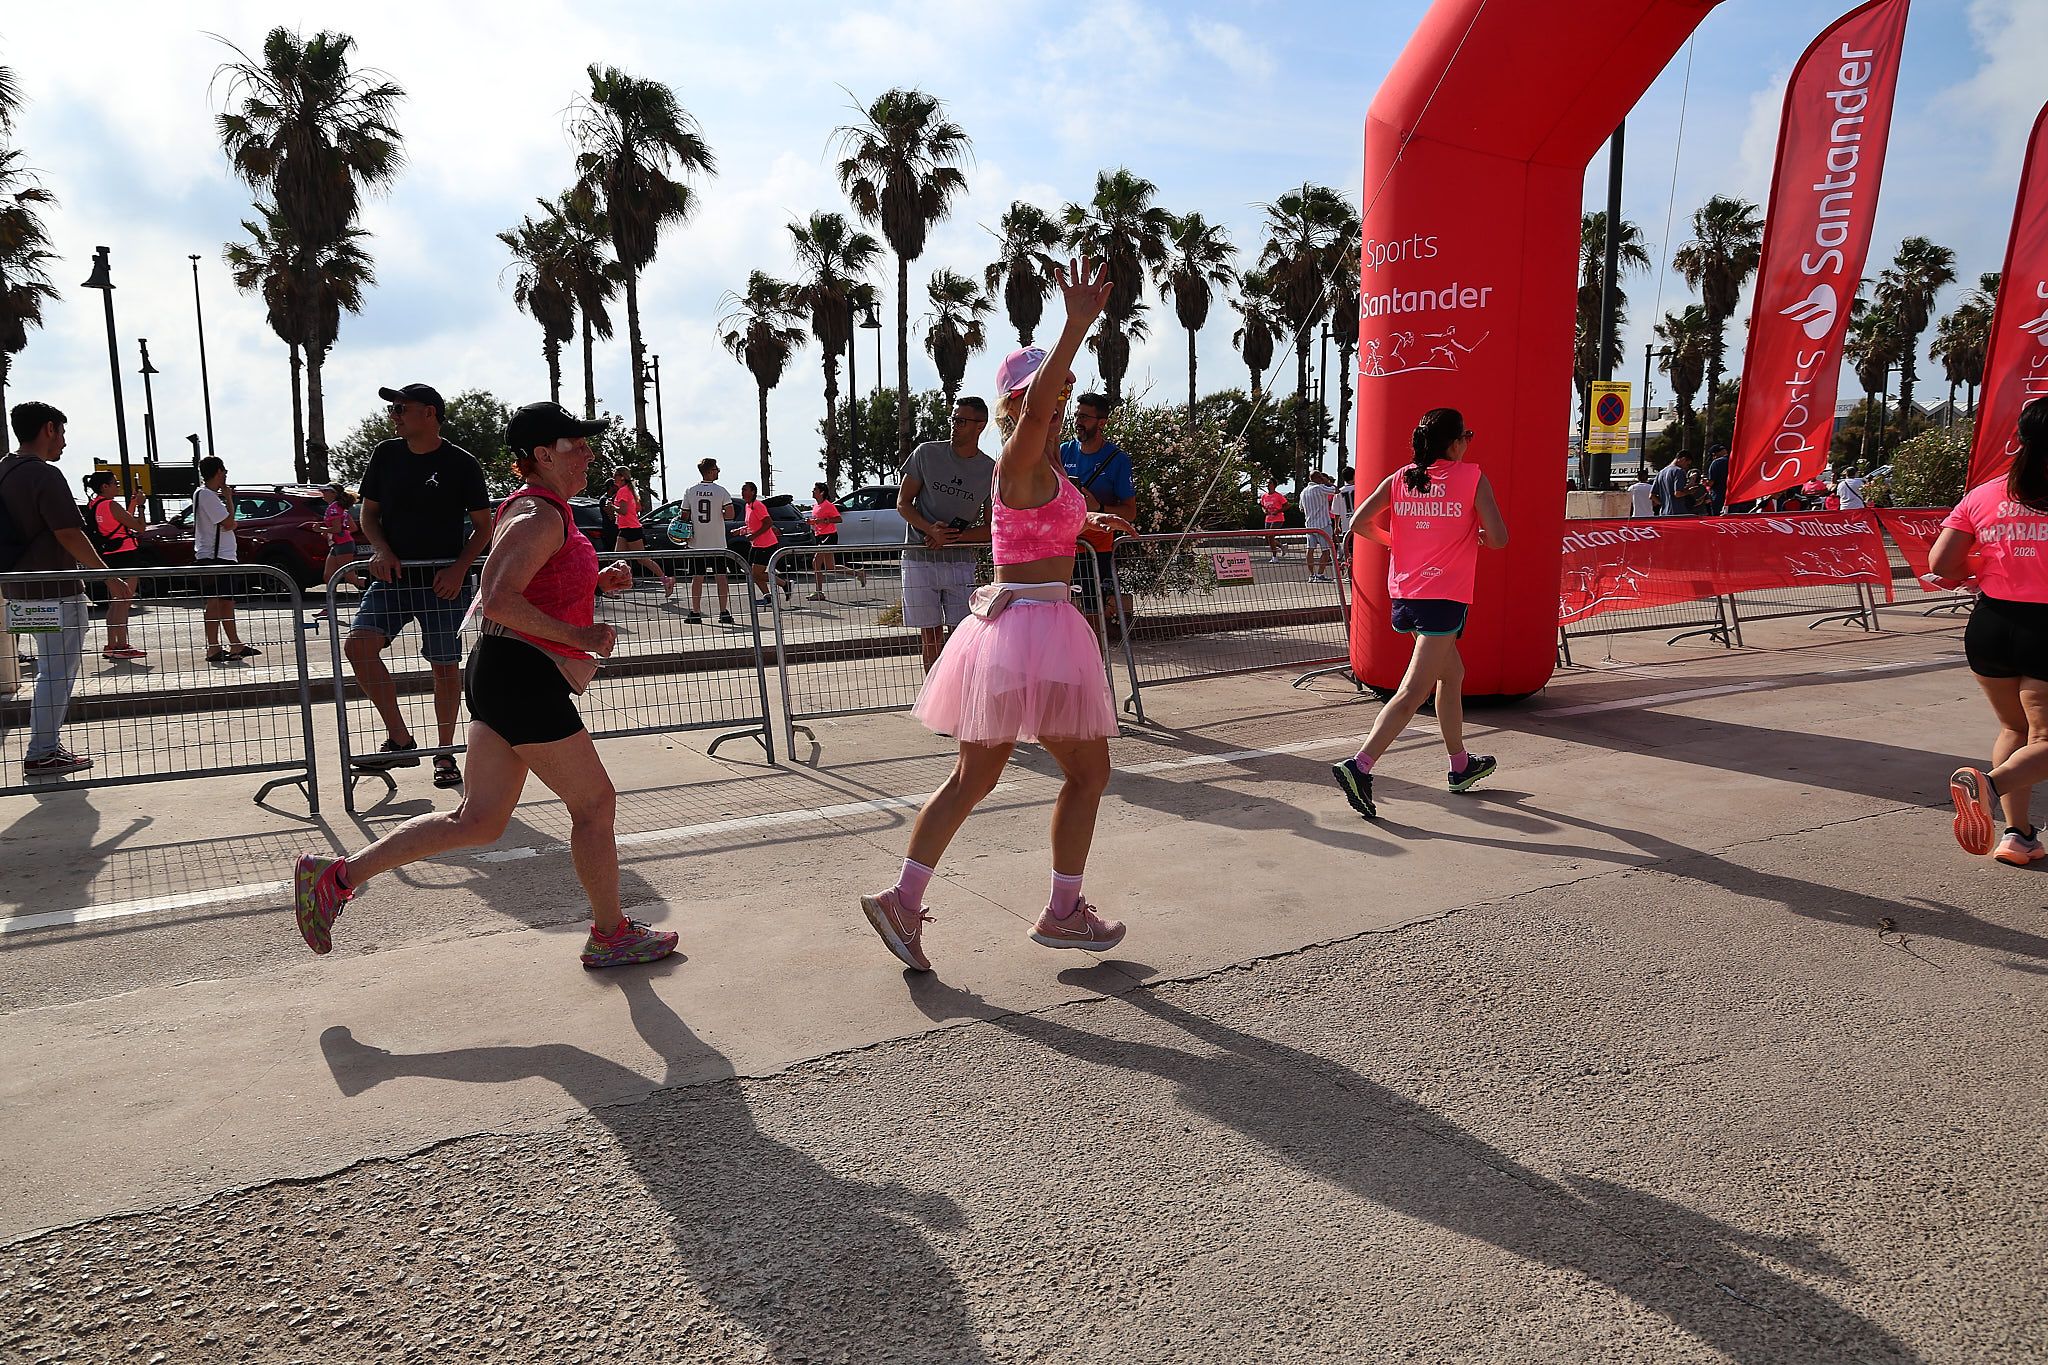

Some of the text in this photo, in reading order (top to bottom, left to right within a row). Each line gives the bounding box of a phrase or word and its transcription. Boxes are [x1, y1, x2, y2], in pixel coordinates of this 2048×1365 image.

[1366, 233, 1438, 273] Sports
[1760, 42, 1874, 481] Sports Santander
[1362, 282, 1493, 319] Santander
[932, 481, 975, 501] SCOTTA
[698, 499, 711, 523] 9
[1785, 517, 1874, 537] Santander
